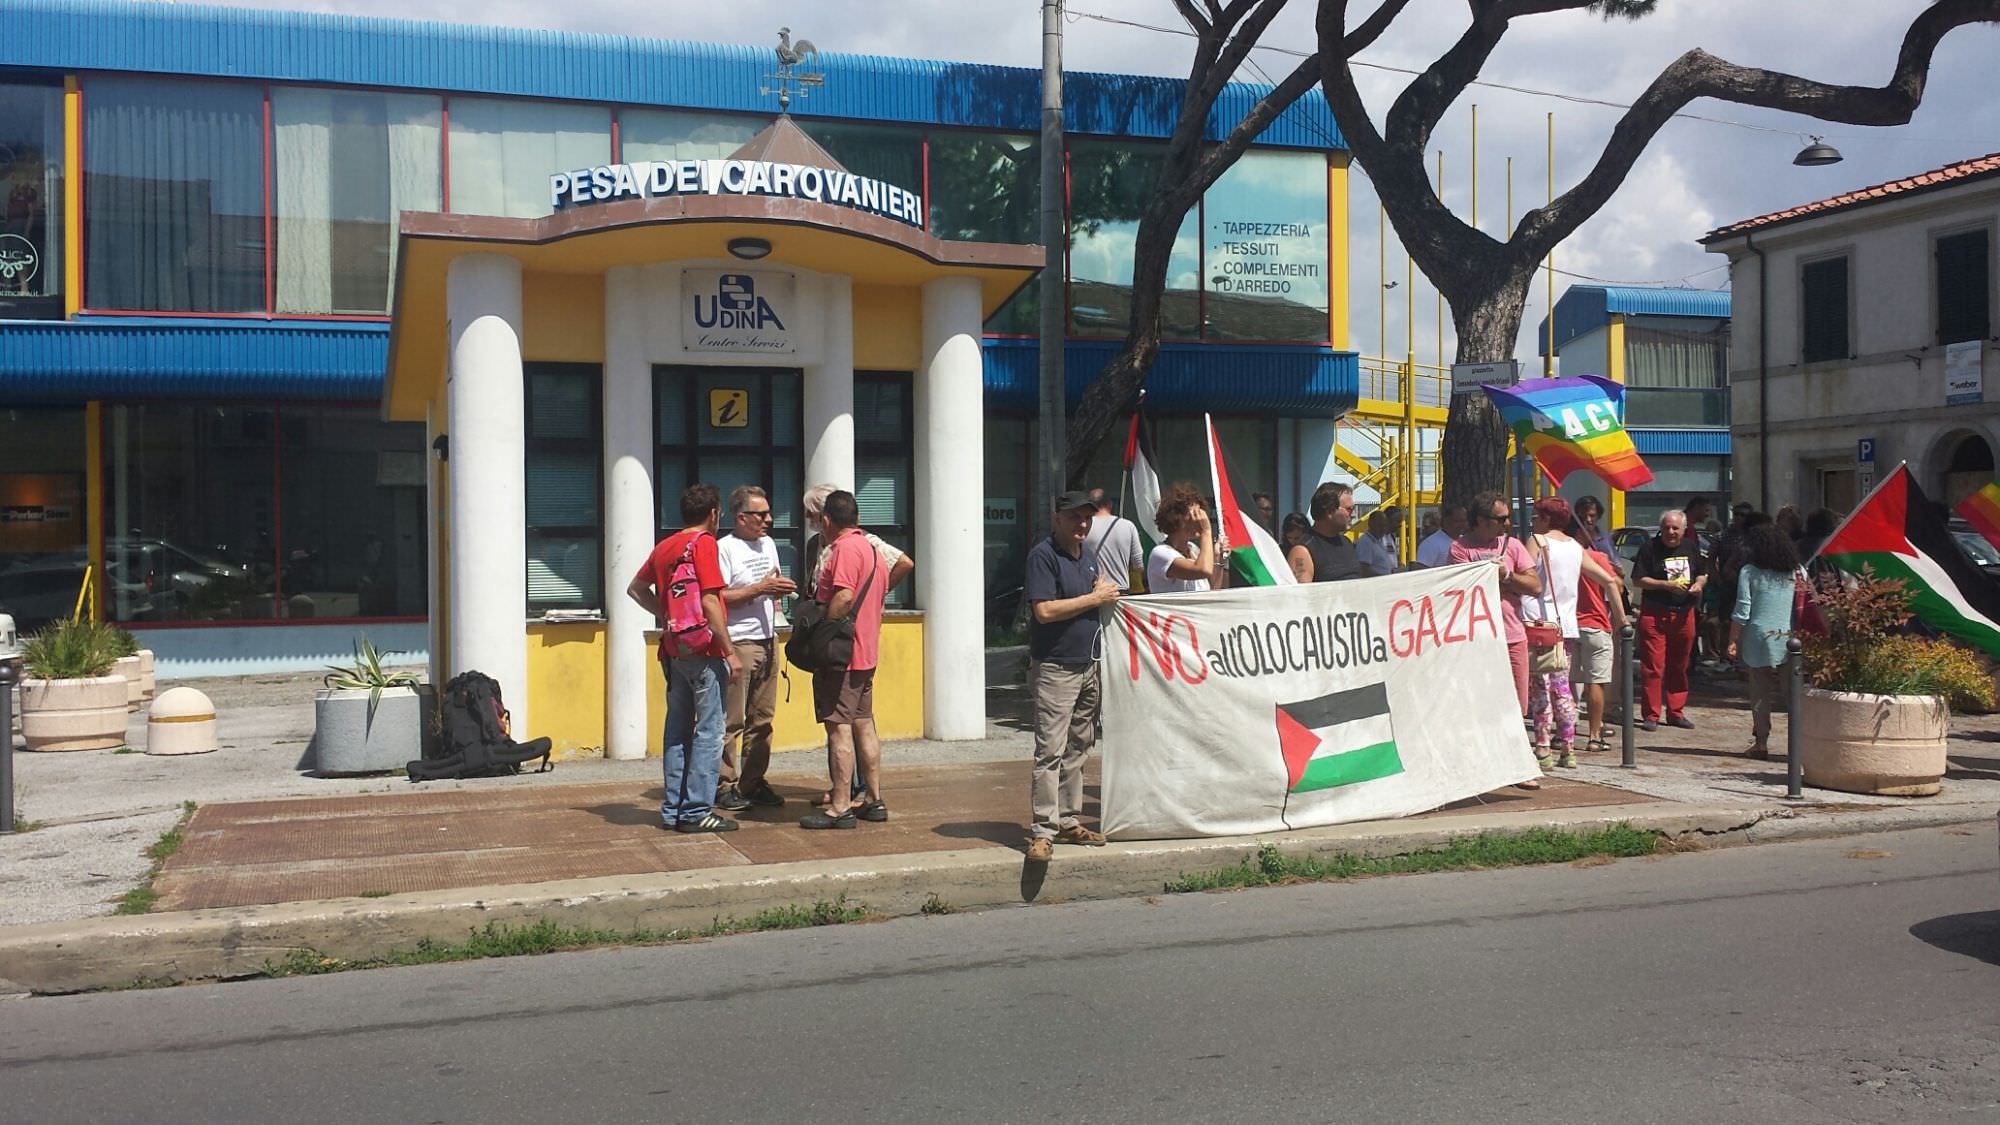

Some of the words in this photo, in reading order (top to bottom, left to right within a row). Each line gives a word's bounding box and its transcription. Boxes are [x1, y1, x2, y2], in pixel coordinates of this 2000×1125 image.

[549, 163, 638, 206] PESA
[650, 159, 710, 194] DEI
[721, 160, 923, 225] CAROVANIERI
[1223, 221, 1310, 237] TAPPEZZERIA
[1223, 241, 1279, 256] TESSUTI
[1223, 261, 1318, 277] COMPLEMENTI
[1223, 279, 1291, 293] D'ARREDO
[694, 294, 785, 331] UDINA
[1861, 441, 1872, 460] P
[983, 504, 1015, 520] tore
[1121, 605, 1208, 685] NO
[1387, 584, 1498, 658] GAZA
